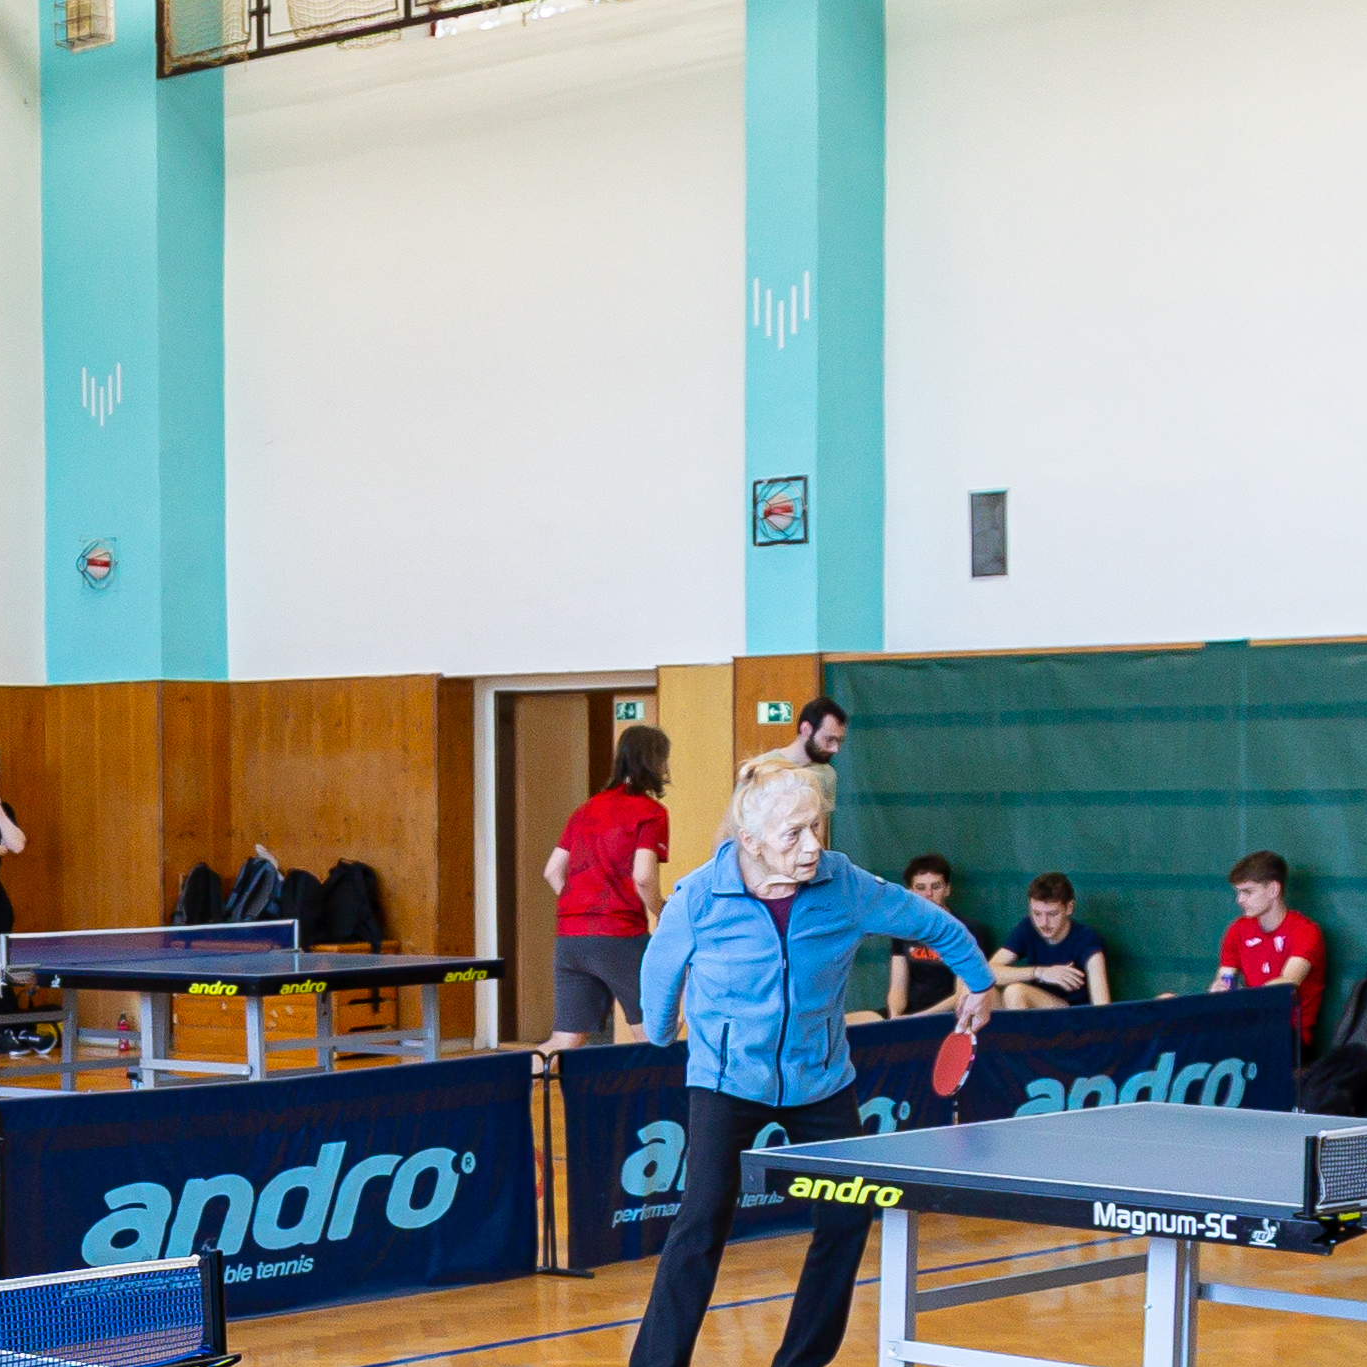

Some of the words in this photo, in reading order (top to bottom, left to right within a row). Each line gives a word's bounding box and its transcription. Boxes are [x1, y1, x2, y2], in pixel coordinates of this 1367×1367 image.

[443, 967, 488, 983] andro
[188, 980, 238, 996] andro
[280, 979, 327, 995] andro
[788, 1176, 904, 1207] andro
[1093, 1201, 1237, 1240] Magnum-SC
[256, 1254, 314, 1279] tennis
